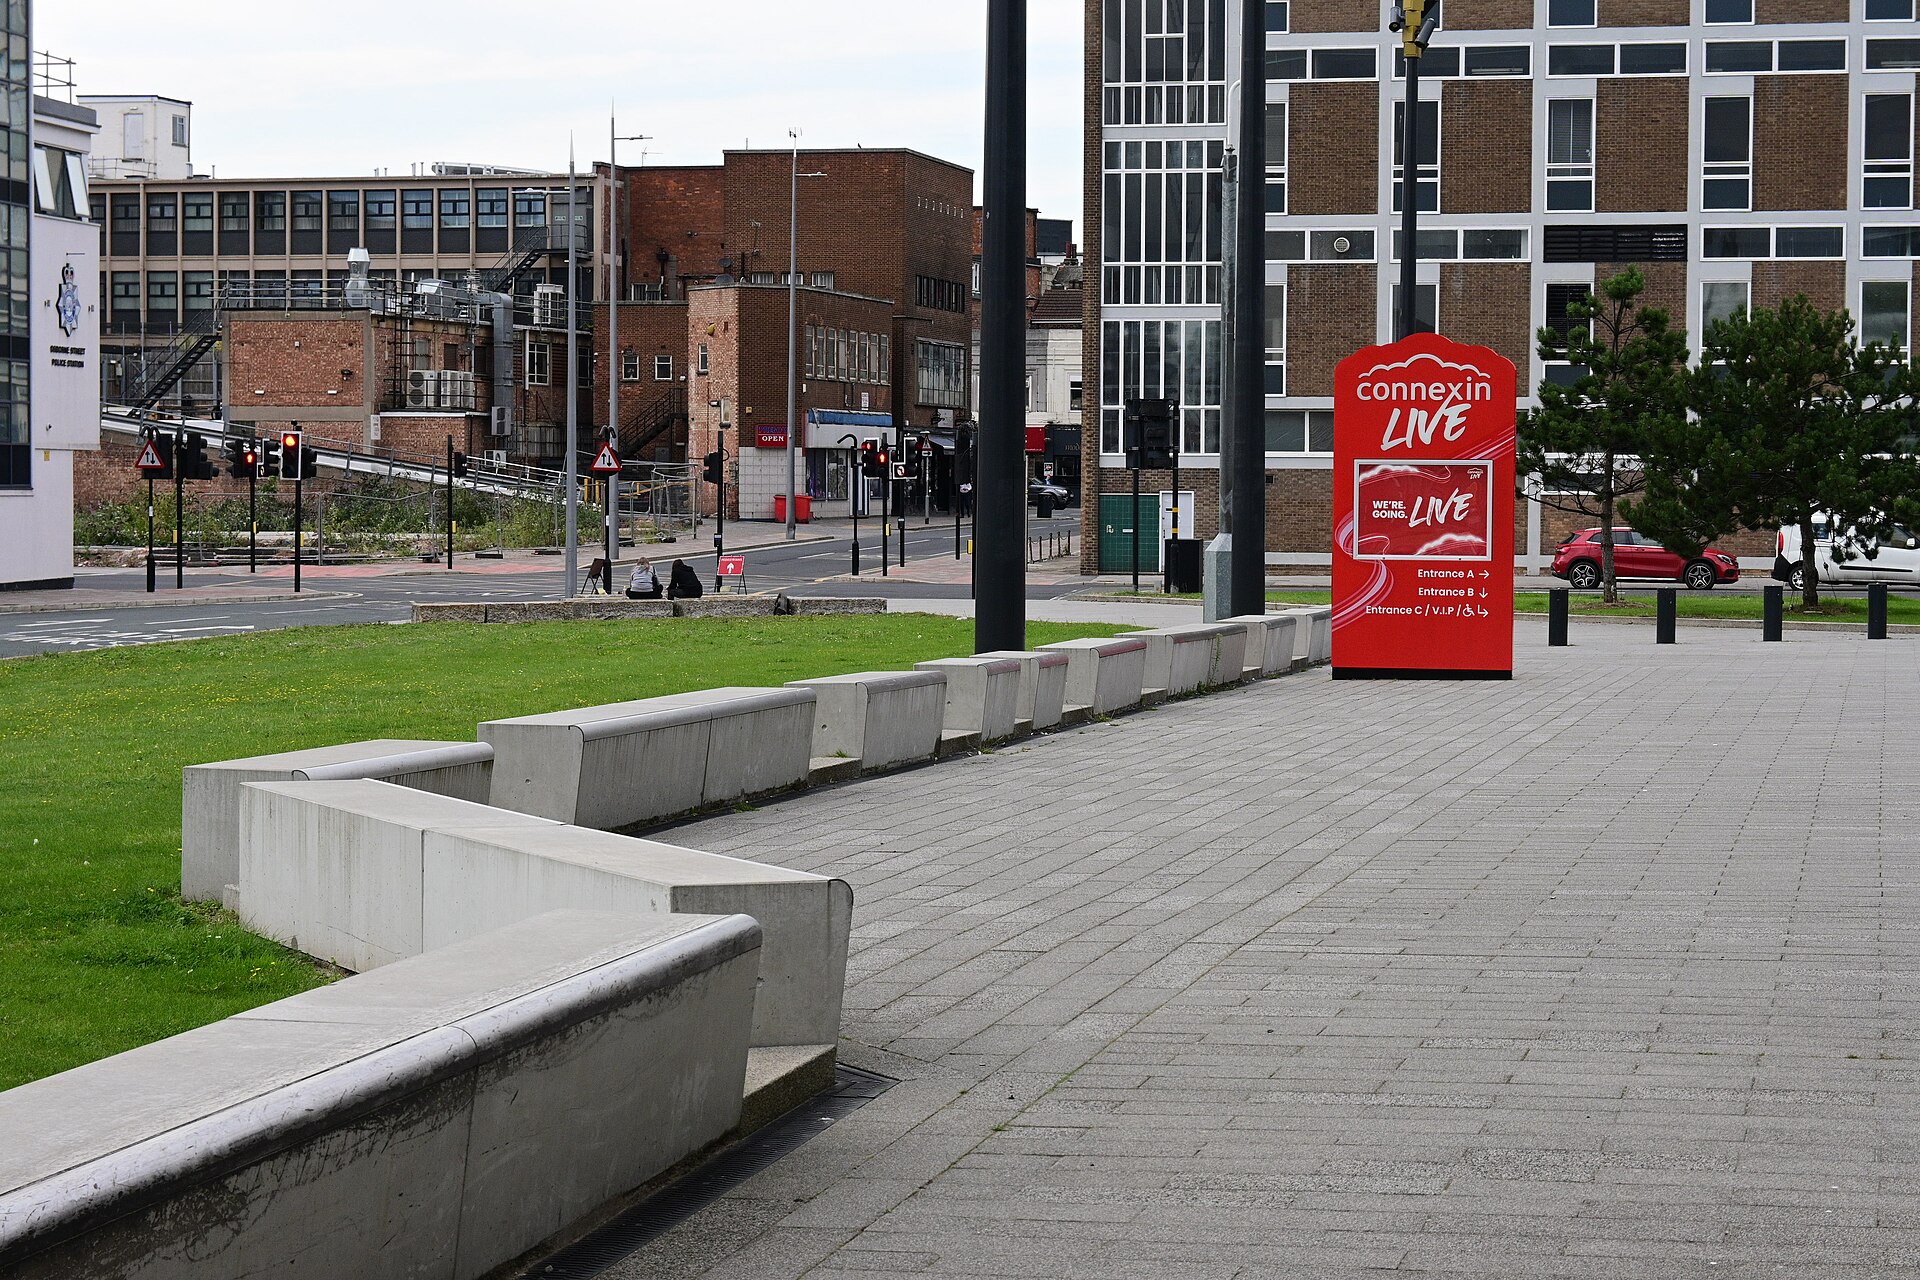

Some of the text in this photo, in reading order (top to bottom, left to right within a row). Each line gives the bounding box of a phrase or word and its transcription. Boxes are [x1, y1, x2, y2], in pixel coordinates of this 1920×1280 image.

[1356, 376, 1491, 401] connexin
[1381, 400, 1471, 451] LIVE
[1408, 487, 1474, 528] LIVE
[1372, 510, 1408, 519] GOING.
[1418, 569, 1475, 578] Entrance A
[1418, 587, 1475, 597] Entrance B
[1366, 605, 1412, 614] Entrance
[1414, 606, 1423, 615] C
[1432, 606, 1455, 615] V.I.P
